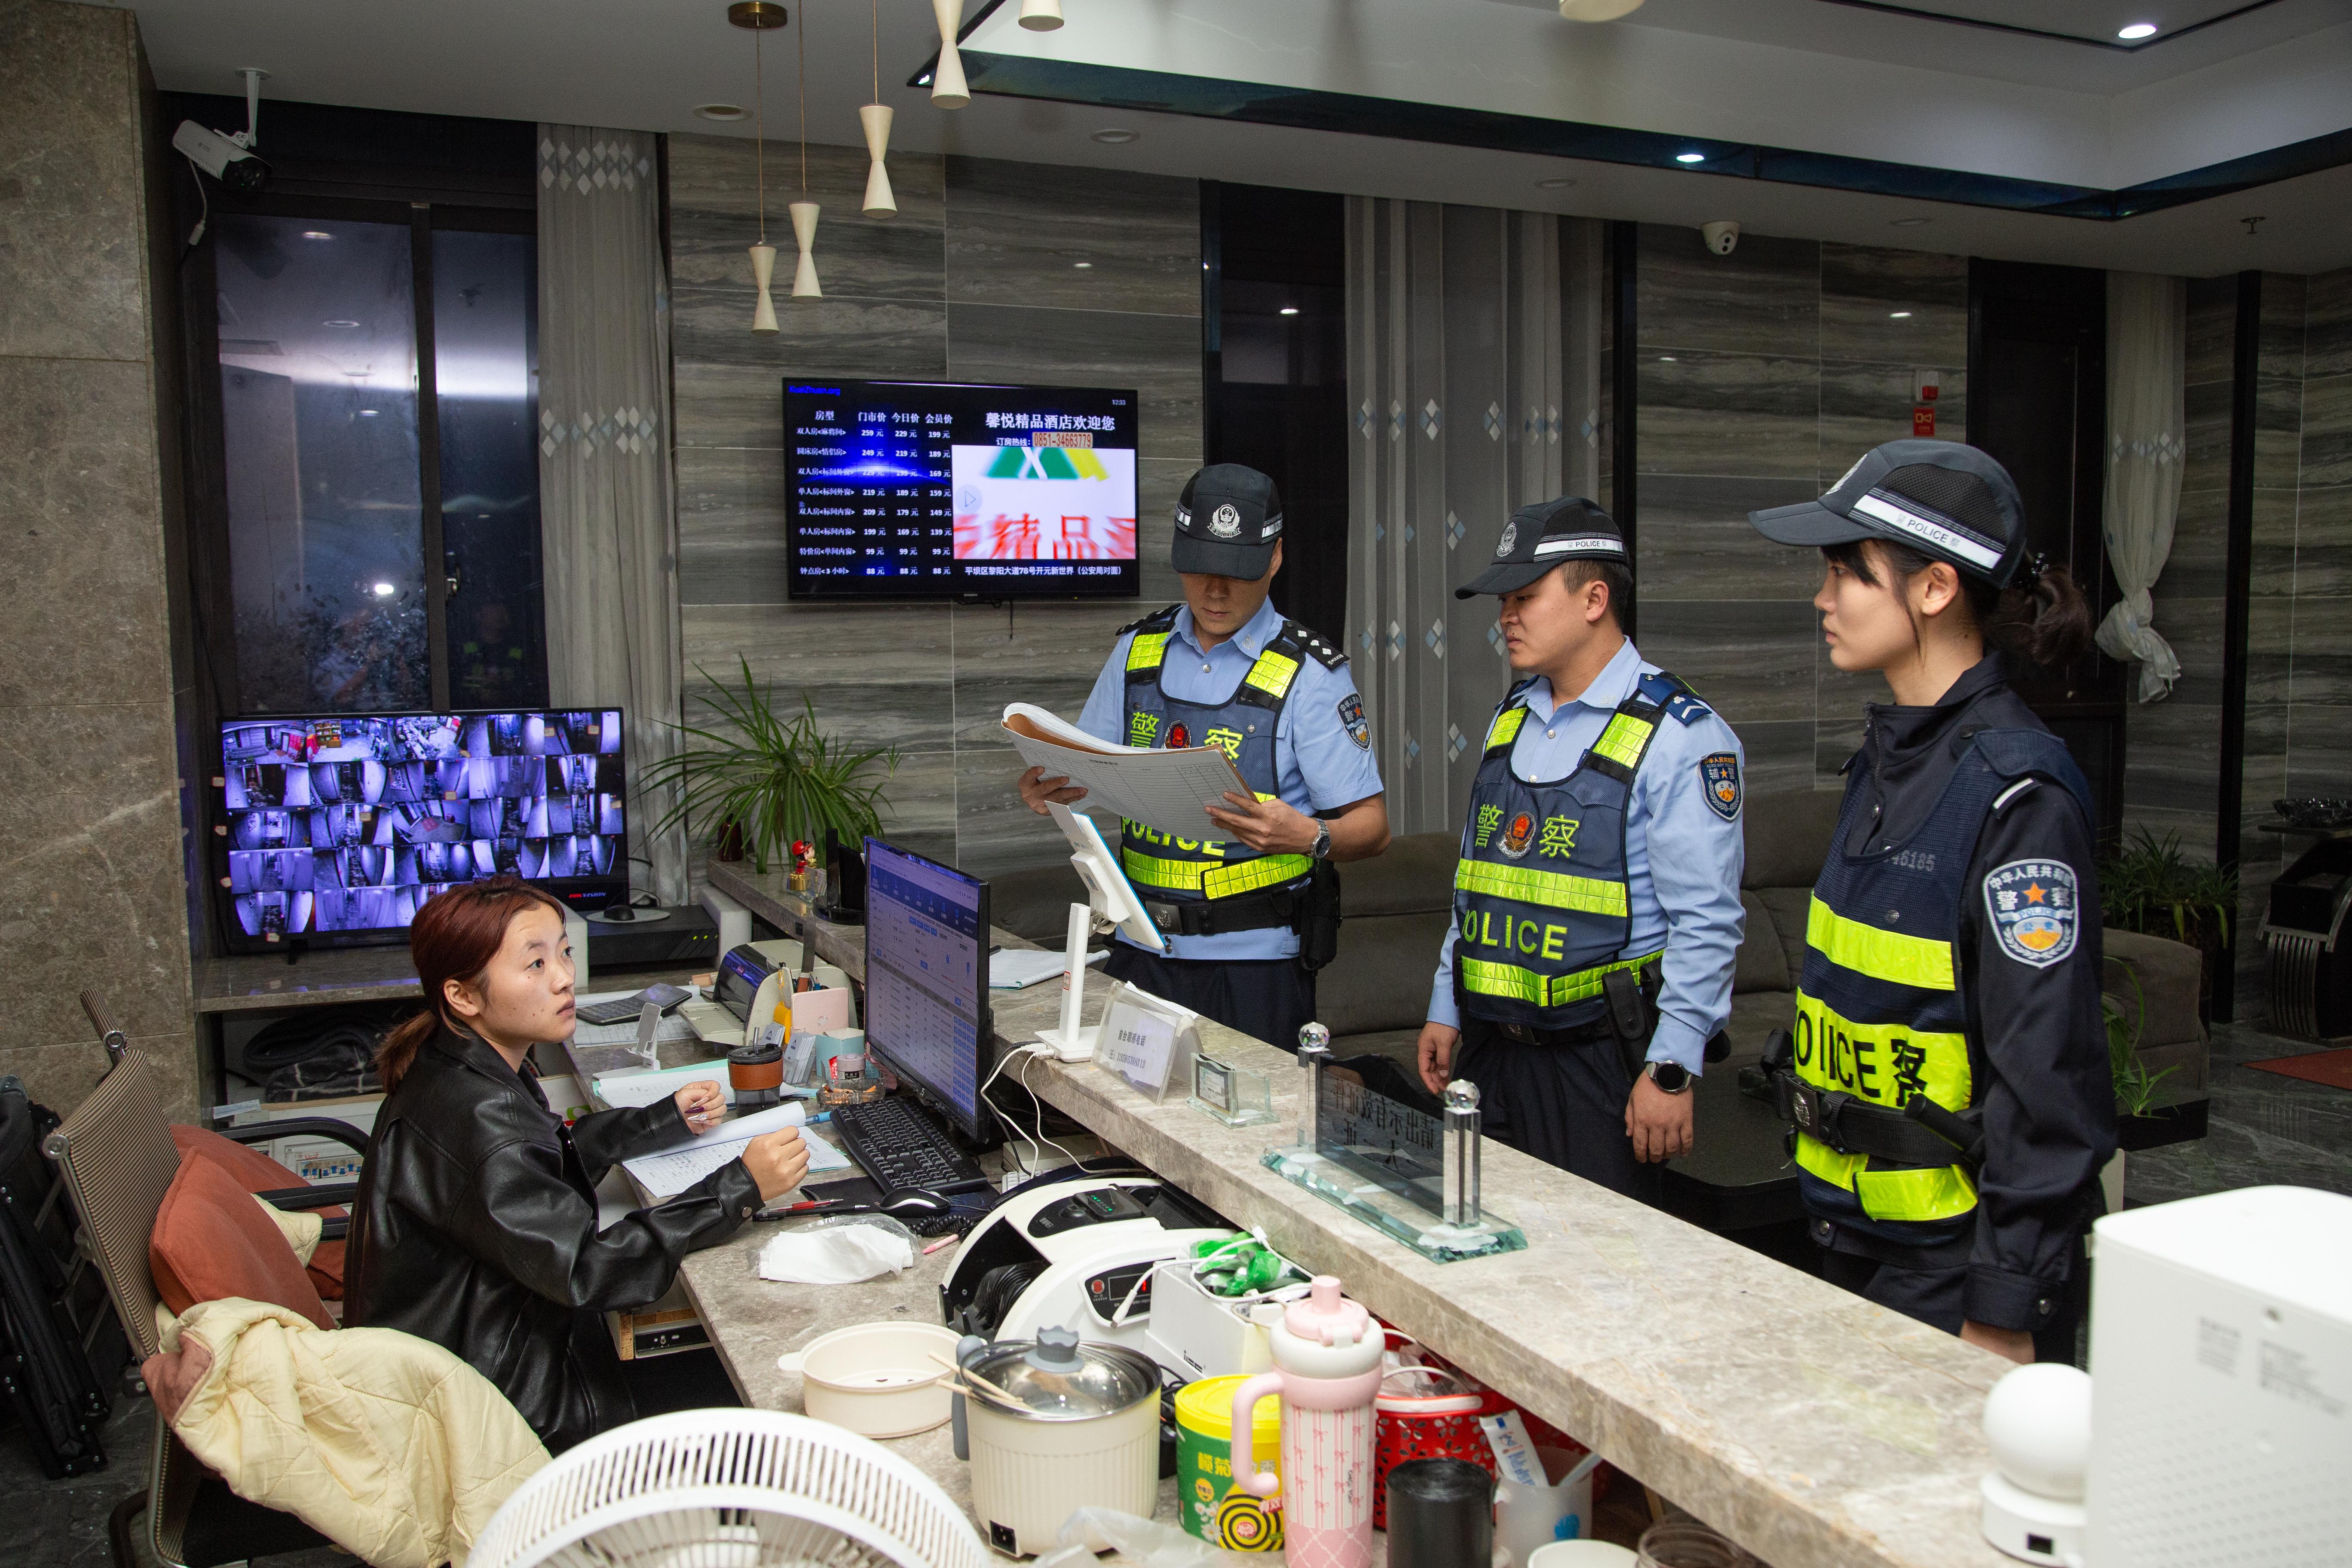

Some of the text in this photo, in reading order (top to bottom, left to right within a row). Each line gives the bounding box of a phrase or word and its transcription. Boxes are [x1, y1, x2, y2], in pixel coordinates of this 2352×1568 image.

[815, 410, 953, 424] 房型 门市价 今日价 会员价
[986, 412, 1115, 430] 馨悦精品酒店欢迎您
[1034, 433, 1091, 447] 0851-34663779
[1907, 519, 1949, 543] POLICE
[1130, 711, 1160, 748] 警
[1709, 768, 1719, 779] 辅
[1476, 803, 1579, 859] 警 察
[1996, 890, 2018, 911] 警
[2018, 907, 2056, 918] POLICE
[1461, 910, 1568, 961] OLICE
[1118, 1029, 1146, 1047] 前台联系电话
[1795, 1010, 1882, 1099] OLICE
